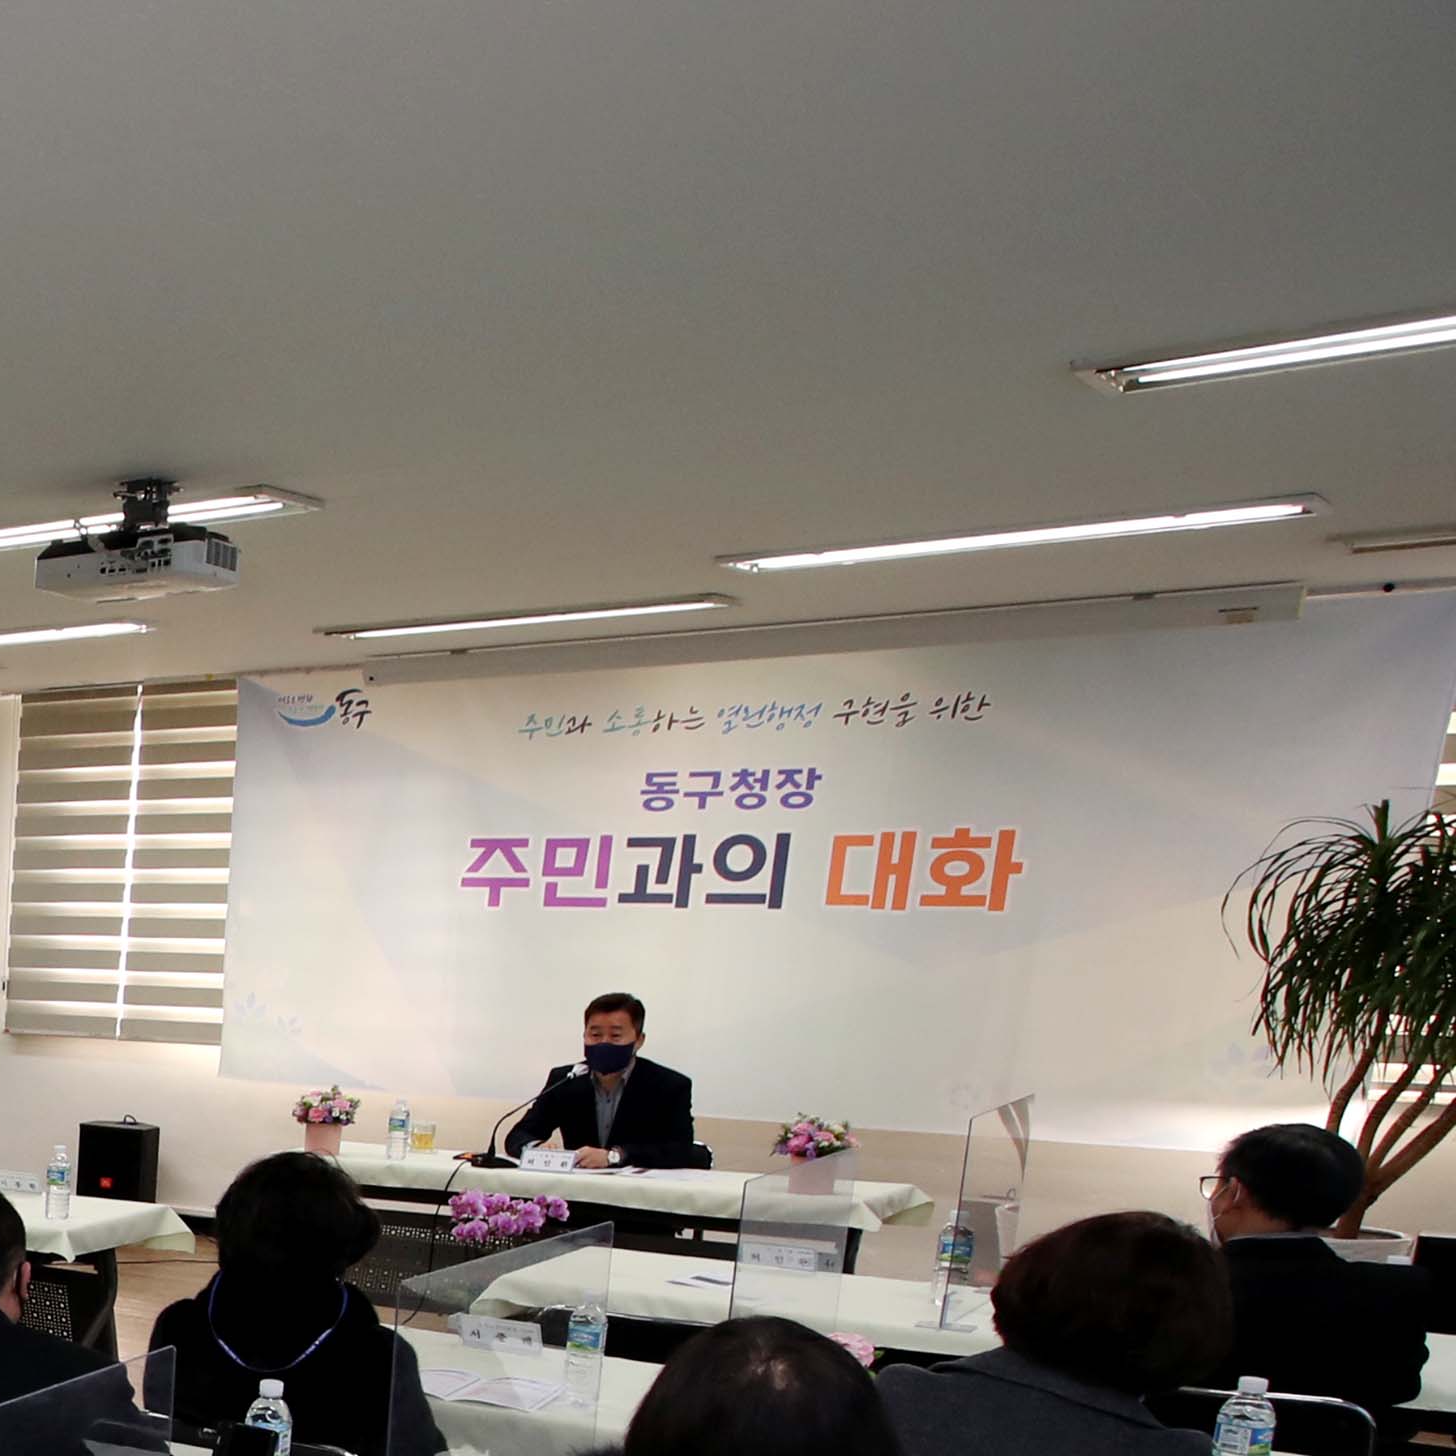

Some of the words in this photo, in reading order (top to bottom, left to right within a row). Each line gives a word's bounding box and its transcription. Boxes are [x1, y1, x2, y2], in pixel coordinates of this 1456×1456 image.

[518, 711, 593, 740] 주민과
[603, 704, 706, 736] 소통하는
[717, 701, 824, 735] 열린행정
[832, 692, 918, 728] 구현을
[929, 690, 992, 721] 위한
[640, 767, 823, 811] 동구청장
[460, 833, 792, 909] 주민과의
[825, 828, 1024, 912] 대화
